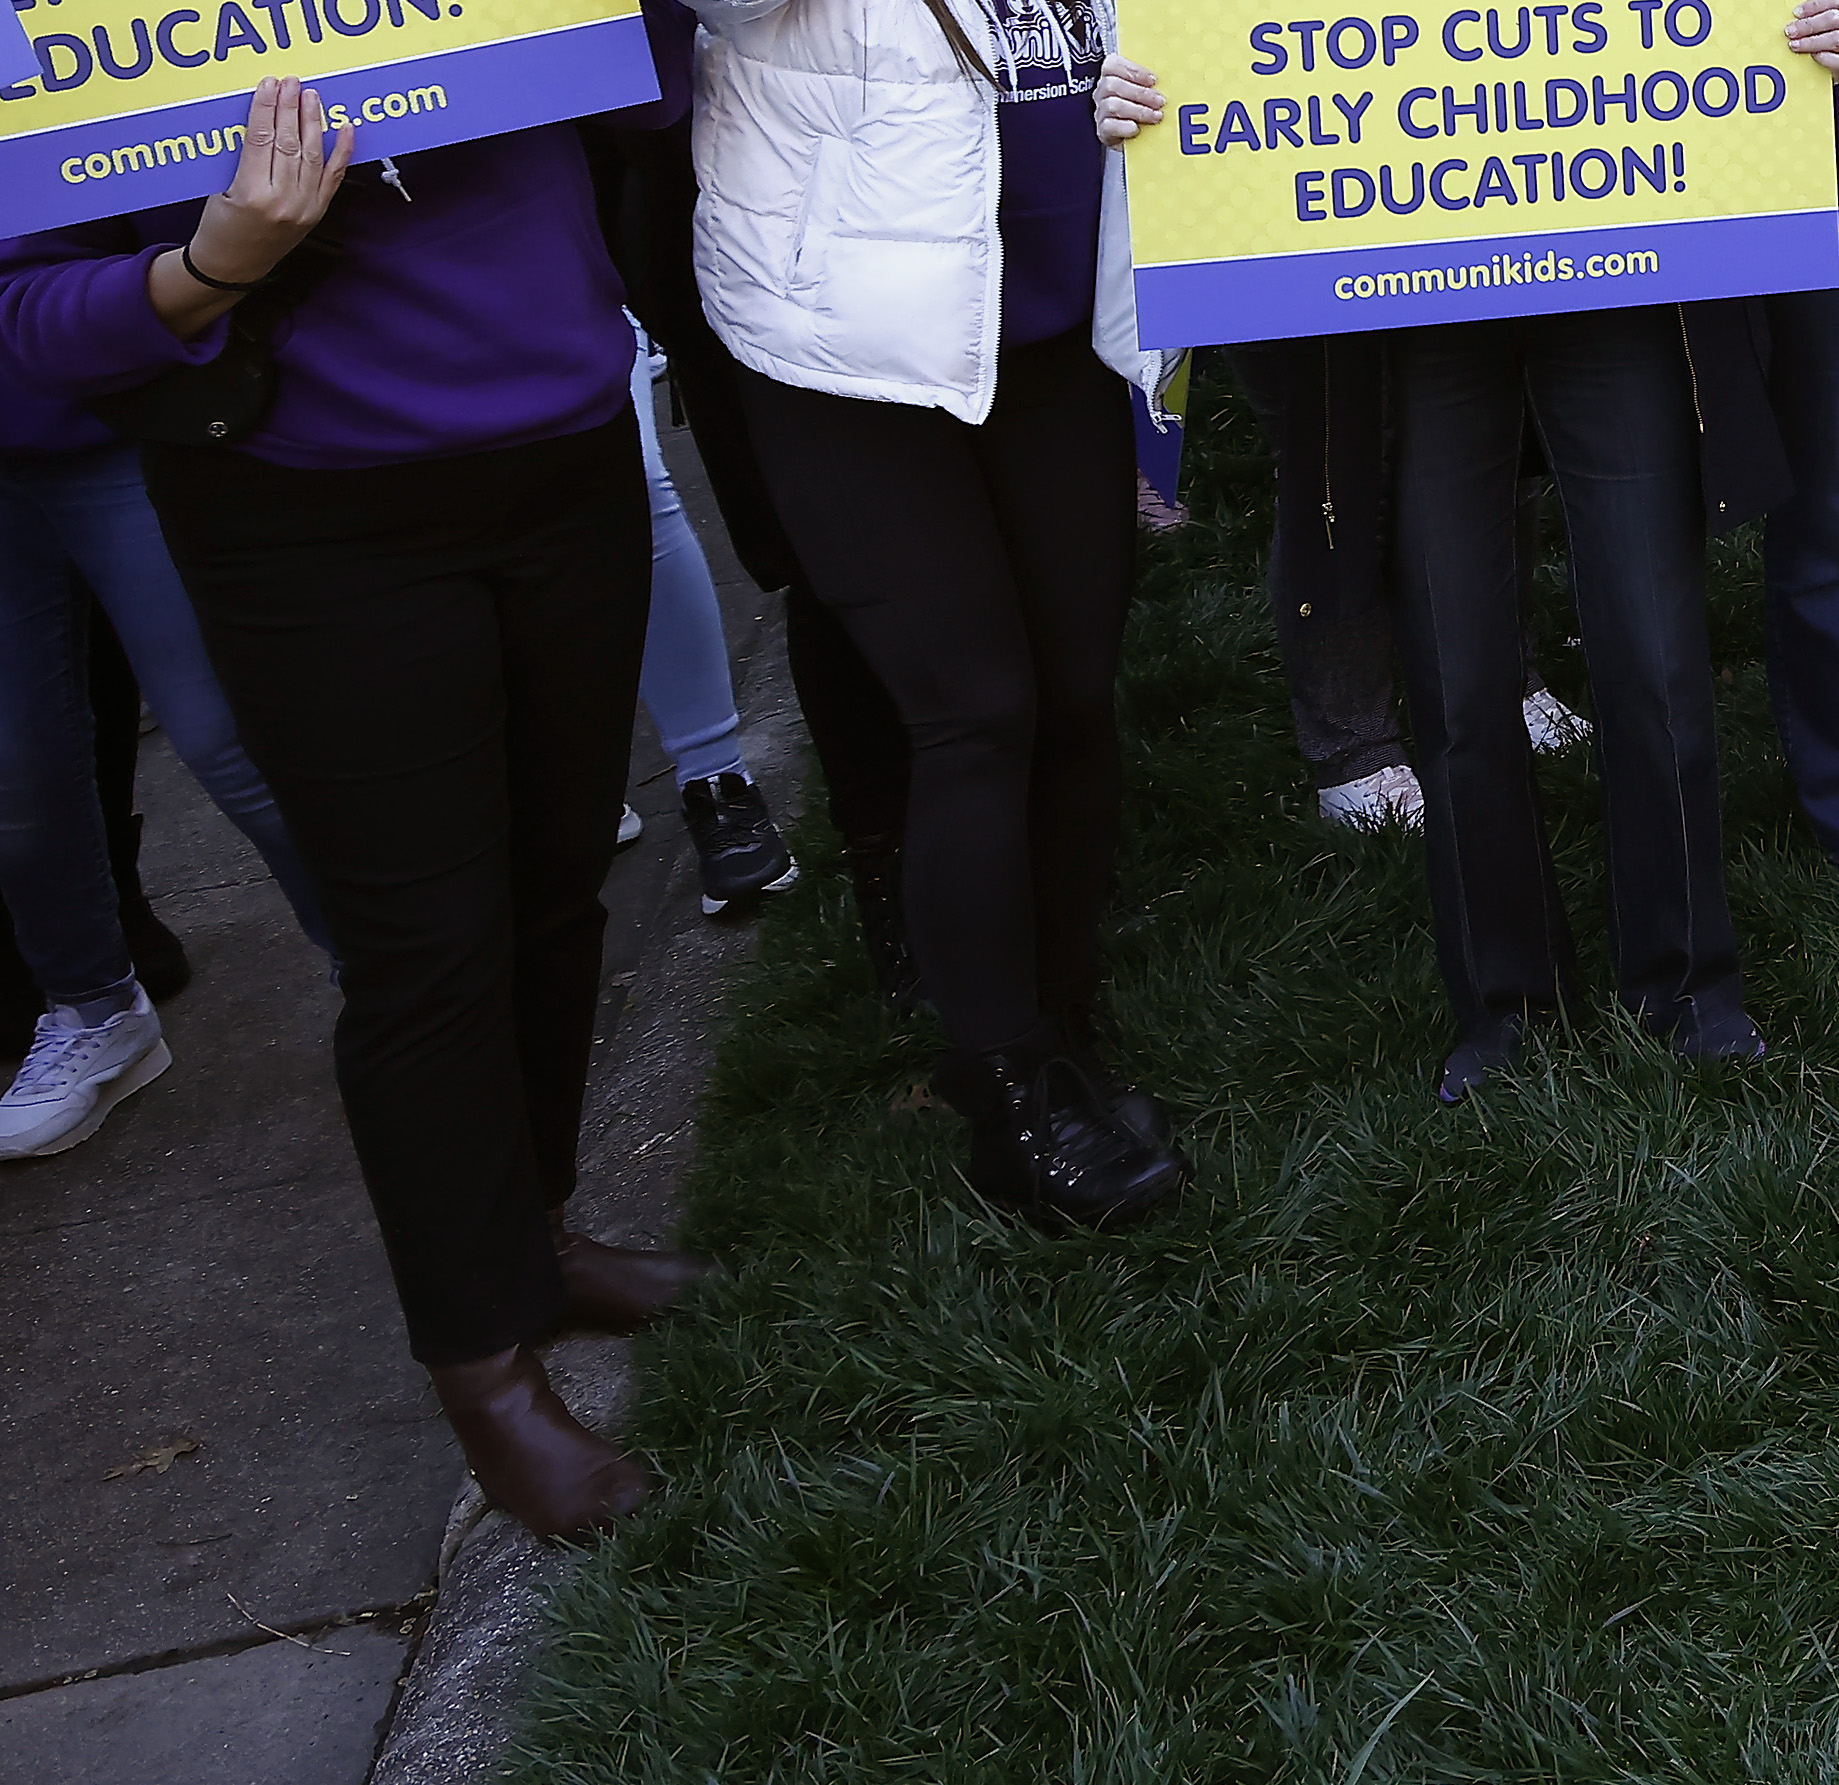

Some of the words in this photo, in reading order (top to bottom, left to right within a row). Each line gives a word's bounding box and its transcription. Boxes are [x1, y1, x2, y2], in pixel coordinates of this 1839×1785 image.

[1250, 15, 1420, 76] STOP
[1442, 2, 1606, 62] CUTS
[1179, 91, 1374, 156] EARLY
[1398, 65, 1786, 139] CHILDHOOD
[1295, 142, 1686, 222] EDUCATION!
[1334, 250, 1658, 300] communikids.com
